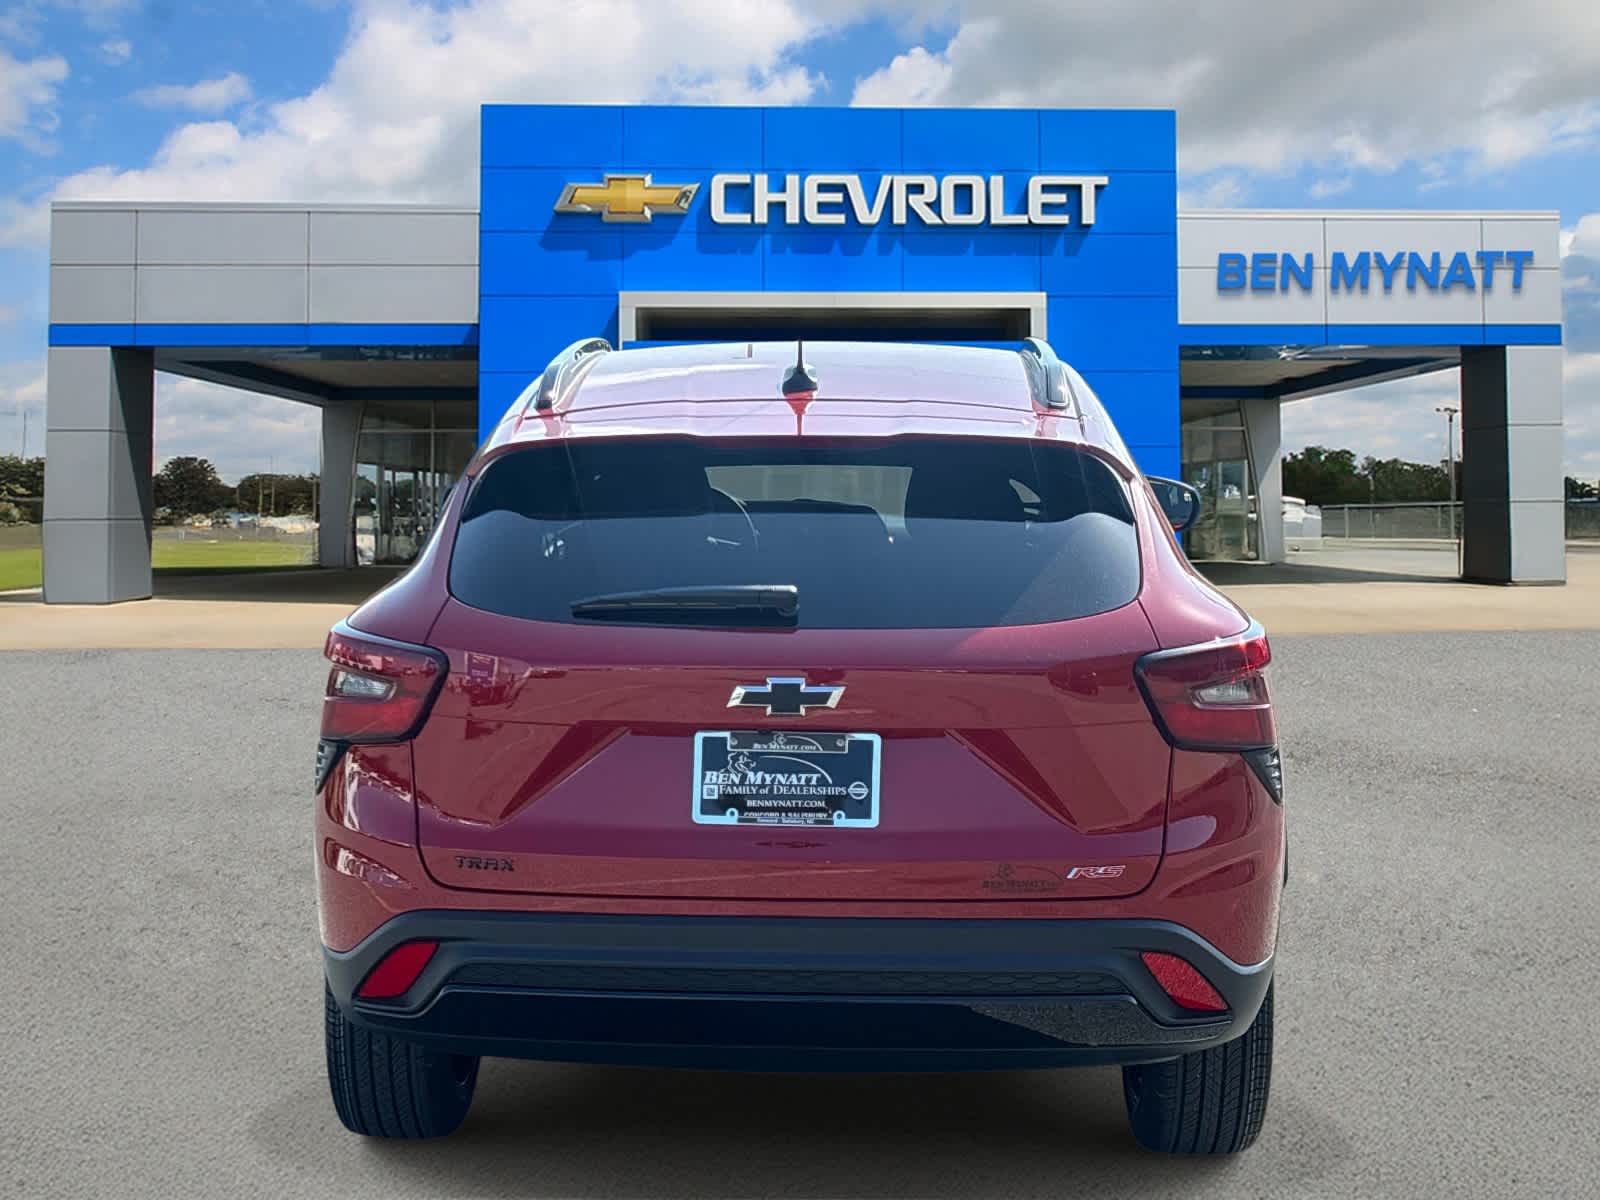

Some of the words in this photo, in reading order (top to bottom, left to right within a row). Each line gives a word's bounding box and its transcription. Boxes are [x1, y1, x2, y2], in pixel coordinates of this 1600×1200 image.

[710, 174, 1109, 225] CHEVROLET
[1217, 252, 1314, 291] BEN
[1330, 250, 1534, 290] MYNATT
[703, 770, 742, 785] BEN
[744, 771, 821, 785] MYNATT
[719, 784, 758, 795] FAMILY
[773, 785, 847, 796] DEALERSHIPS
[746, 800, 826, 808] BENMYNATT.COM
[1066, 865, 1126, 880] RS
